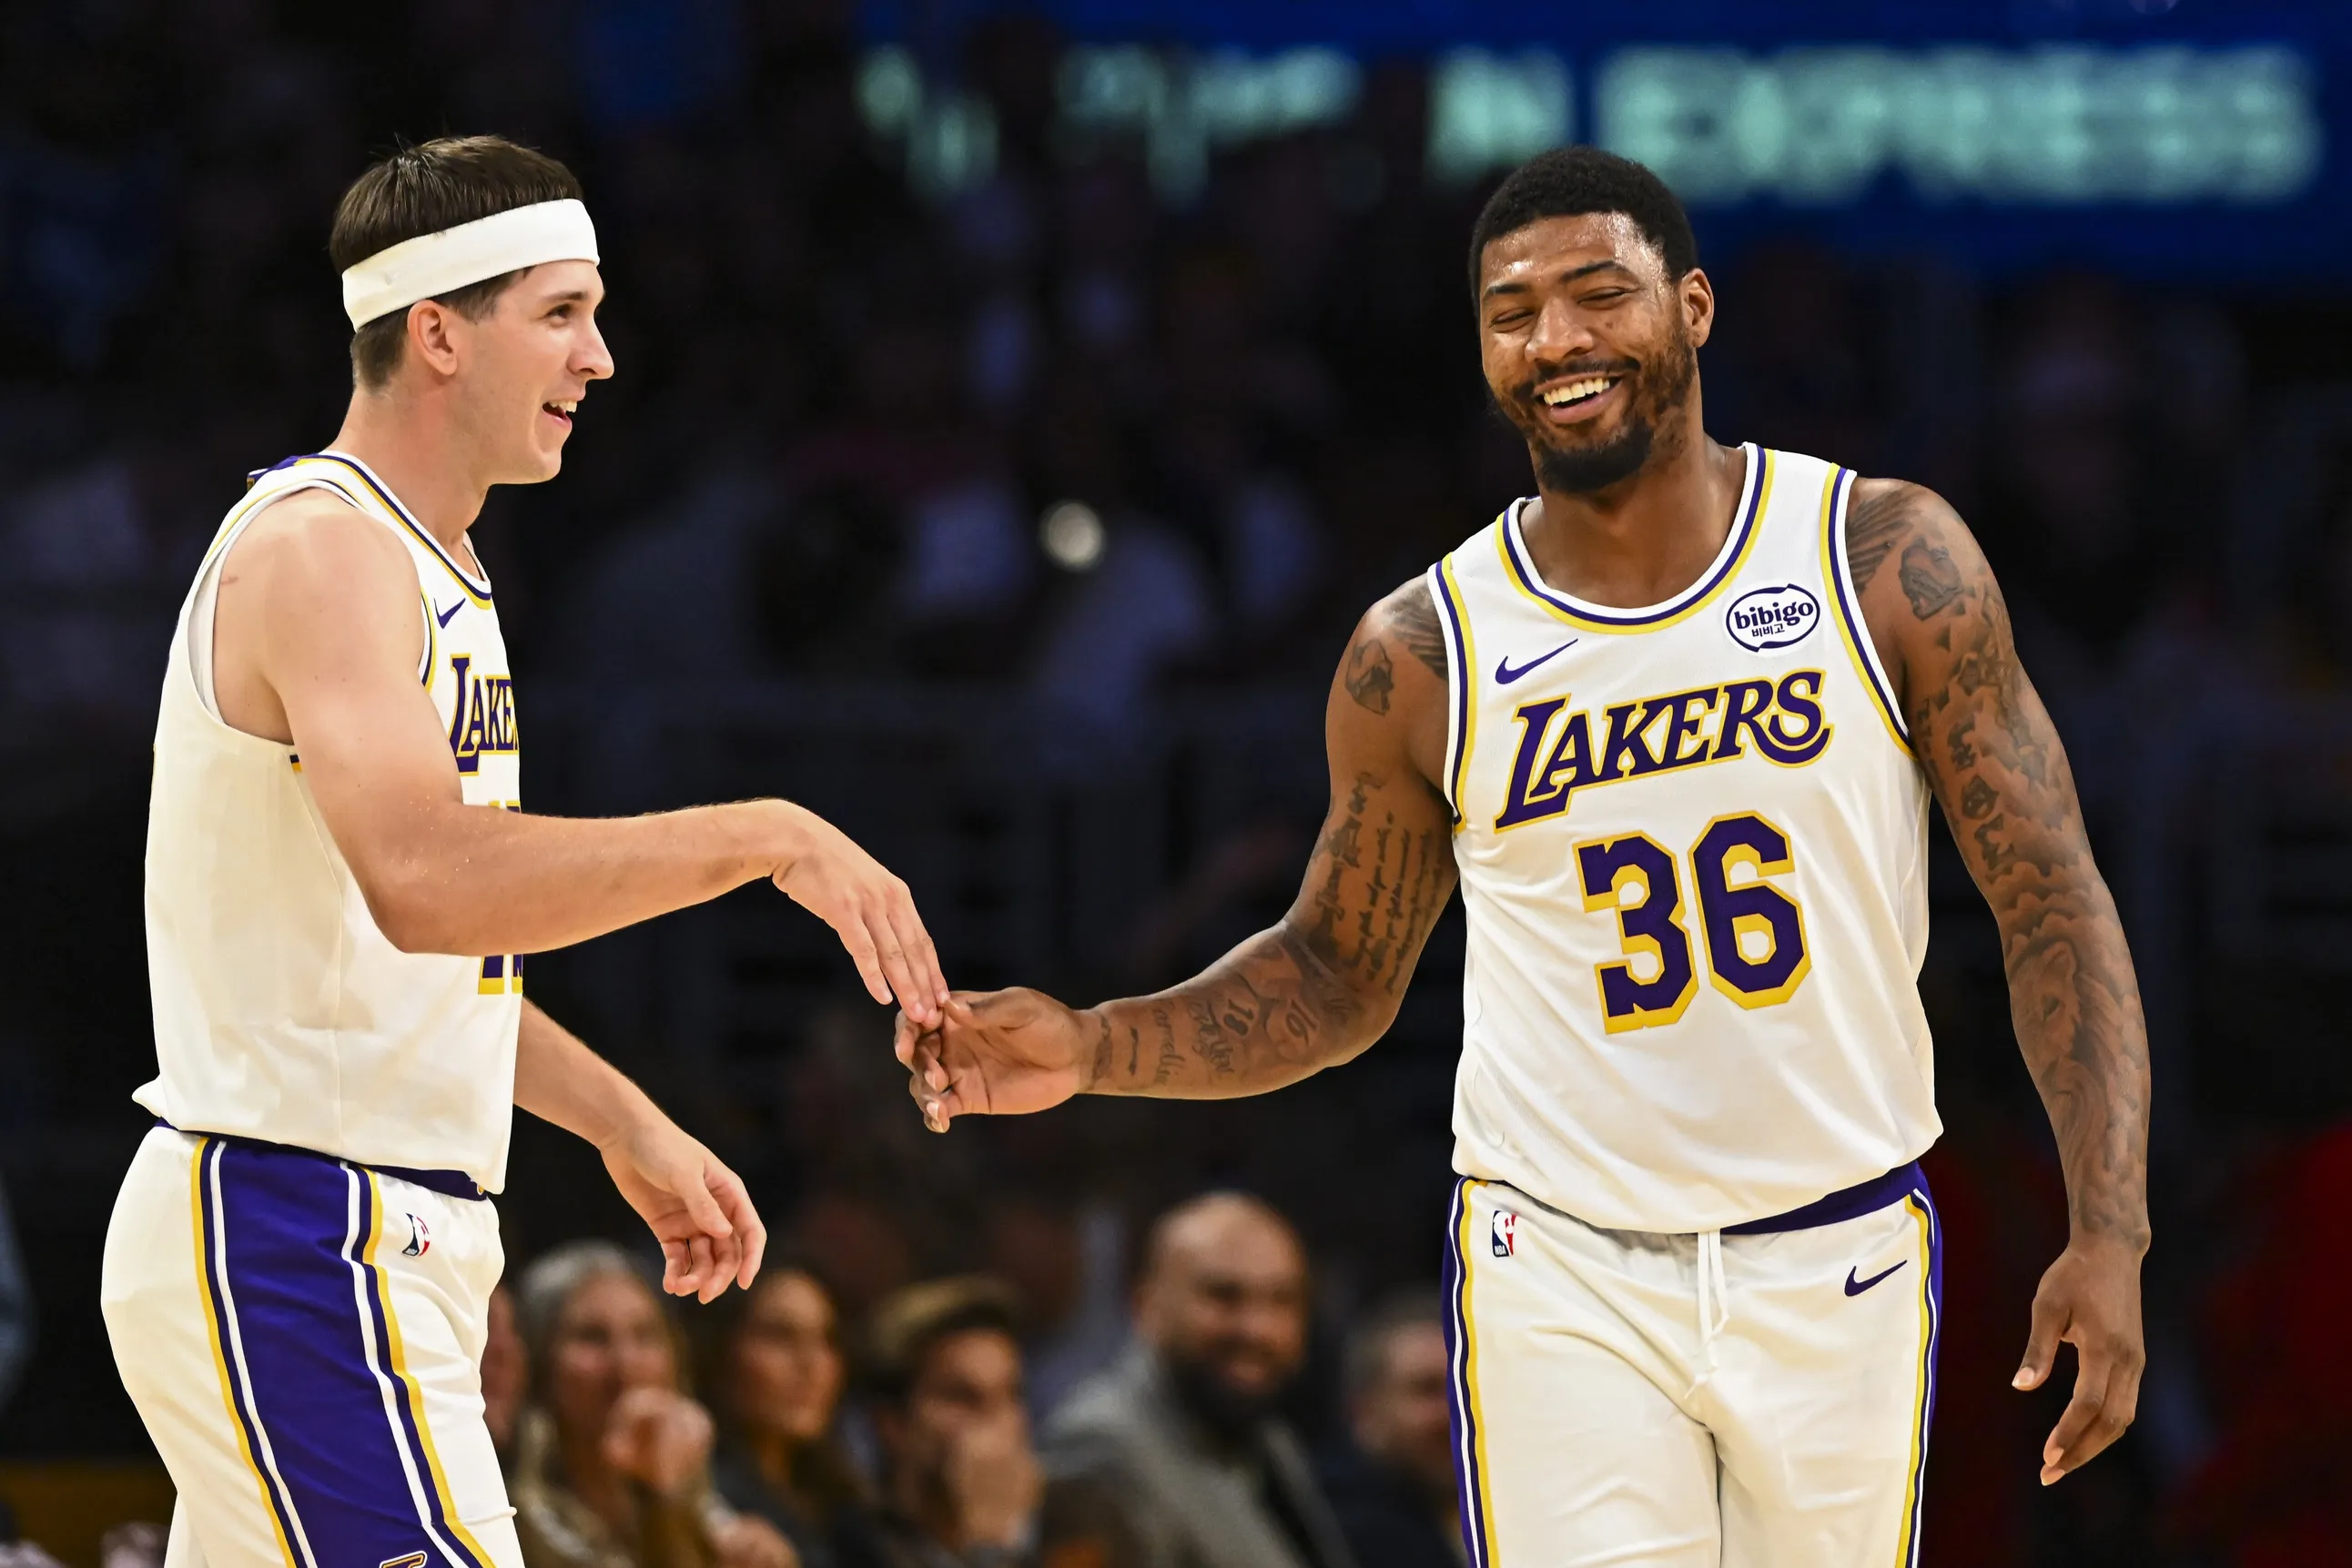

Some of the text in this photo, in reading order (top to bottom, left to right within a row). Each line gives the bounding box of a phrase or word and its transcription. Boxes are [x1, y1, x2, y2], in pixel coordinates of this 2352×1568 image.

[1734, 602, 1813, 629] bibigo
[1751, 623, 1785, 637] 비비고
[447, 652, 520, 777] LAKE
[1494, 669, 1835, 835] LAKERS
[1572, 810, 1812, 1035] 36
[1494, 1244, 1507, 1256] NBA
